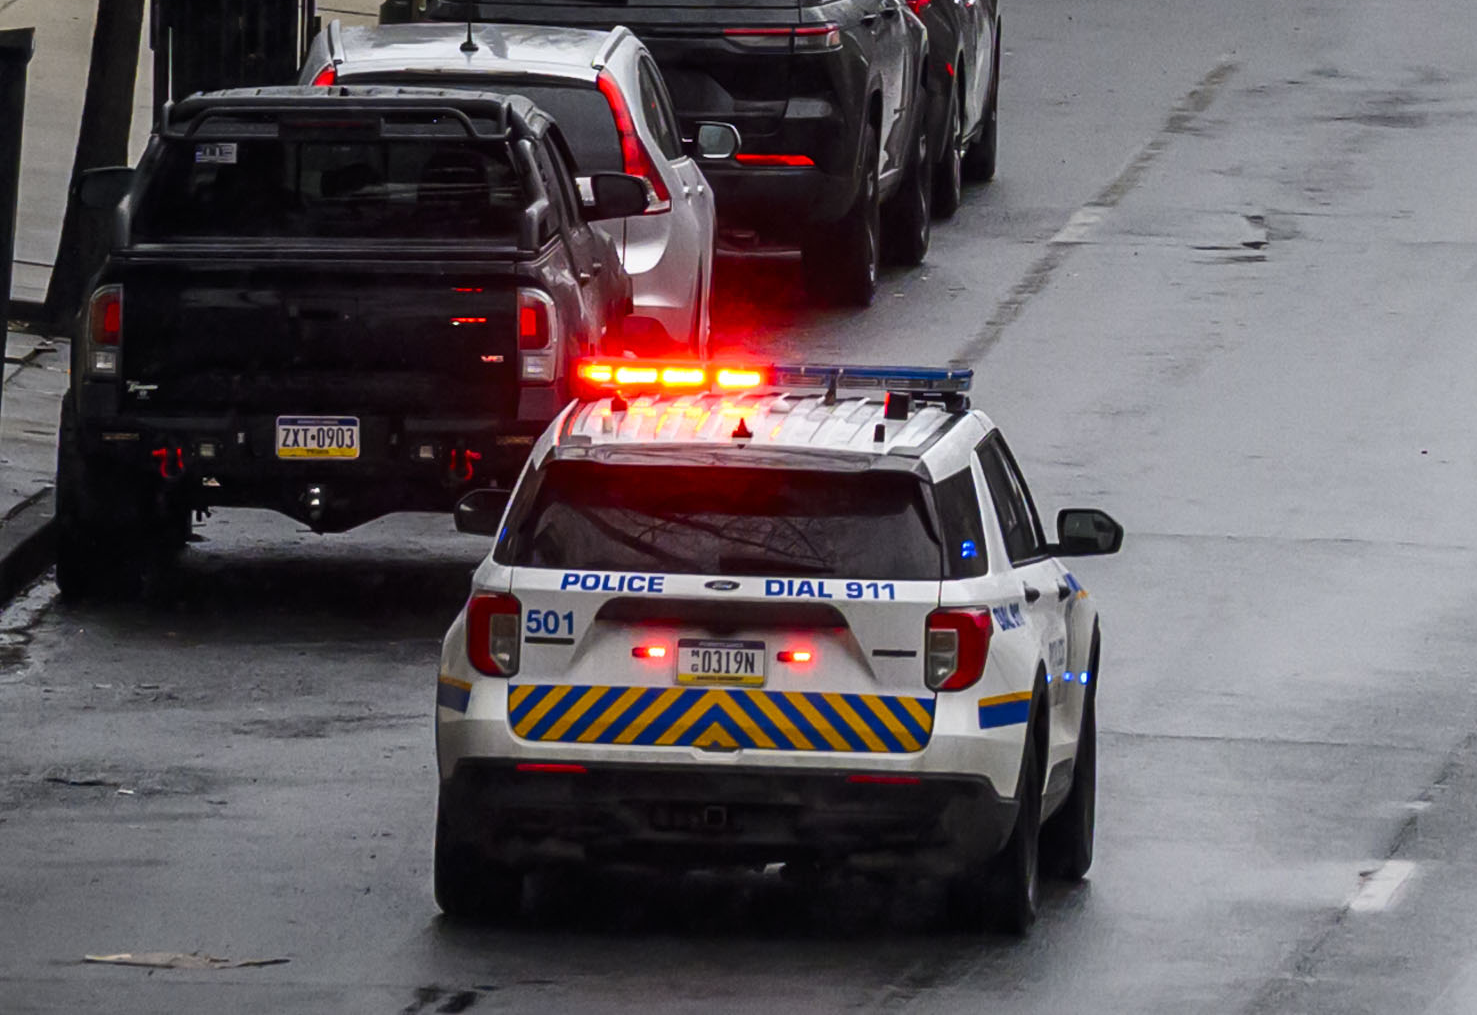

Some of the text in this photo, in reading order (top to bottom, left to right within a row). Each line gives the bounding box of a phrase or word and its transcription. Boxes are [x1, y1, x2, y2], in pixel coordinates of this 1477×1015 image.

[560, 573, 665, 592] POLICE
[764, 579, 895, 600] DIAL 911
[526, 609, 575, 635] 501
[701, 650, 755, 674] 0319N
